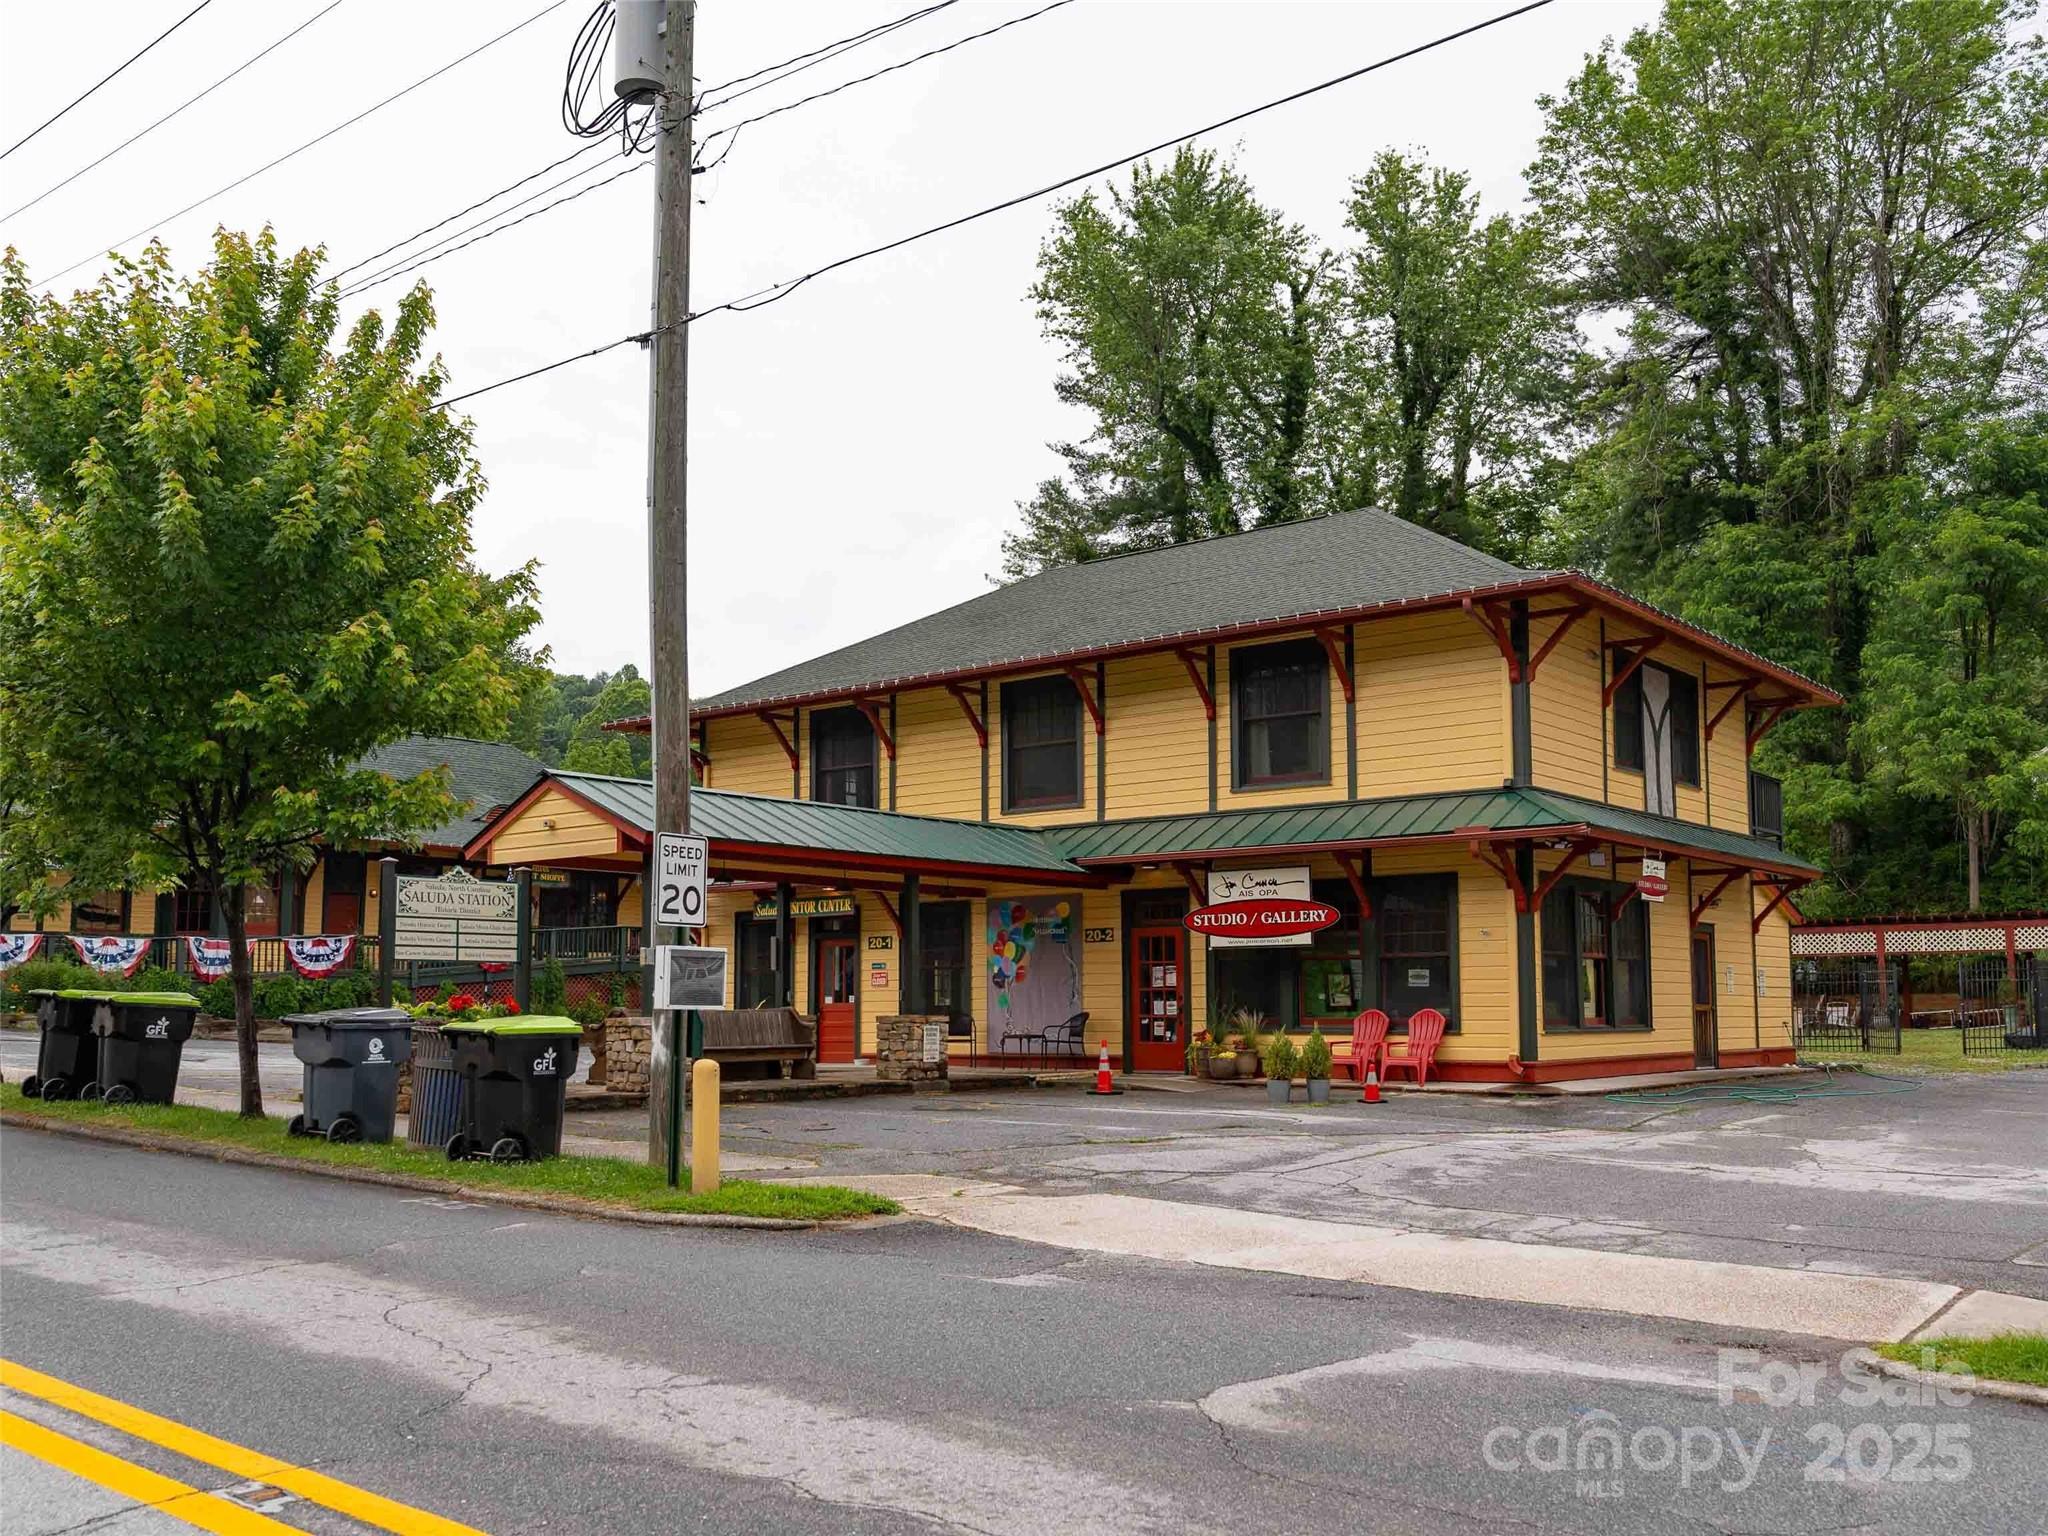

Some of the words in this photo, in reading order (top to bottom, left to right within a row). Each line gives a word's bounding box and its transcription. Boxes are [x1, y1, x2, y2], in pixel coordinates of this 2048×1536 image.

[663, 844, 703, 860] SPEED
[666, 861, 699, 877] LIMIT
[404, 890, 455, 905] SALUDA
[458, 892, 511, 907] STATION
[661, 883, 701, 916] 20
[1238, 889, 1254, 897] AIS
[1258, 888, 1279, 897] OPA
[756, 903, 778, 917] Salud
[818, 898, 852, 913] CENTER
[1193, 912, 1247, 927] STUDIO
[1250, 912, 1258, 926] /
[1260, 909, 1329, 924] GALLERY
[870, 937, 891, 948] 20-1
[1086, 929, 1113, 942] 20-2
[146, 1022, 168, 1036] GFL
[533, 1055, 556, 1071] GFL
